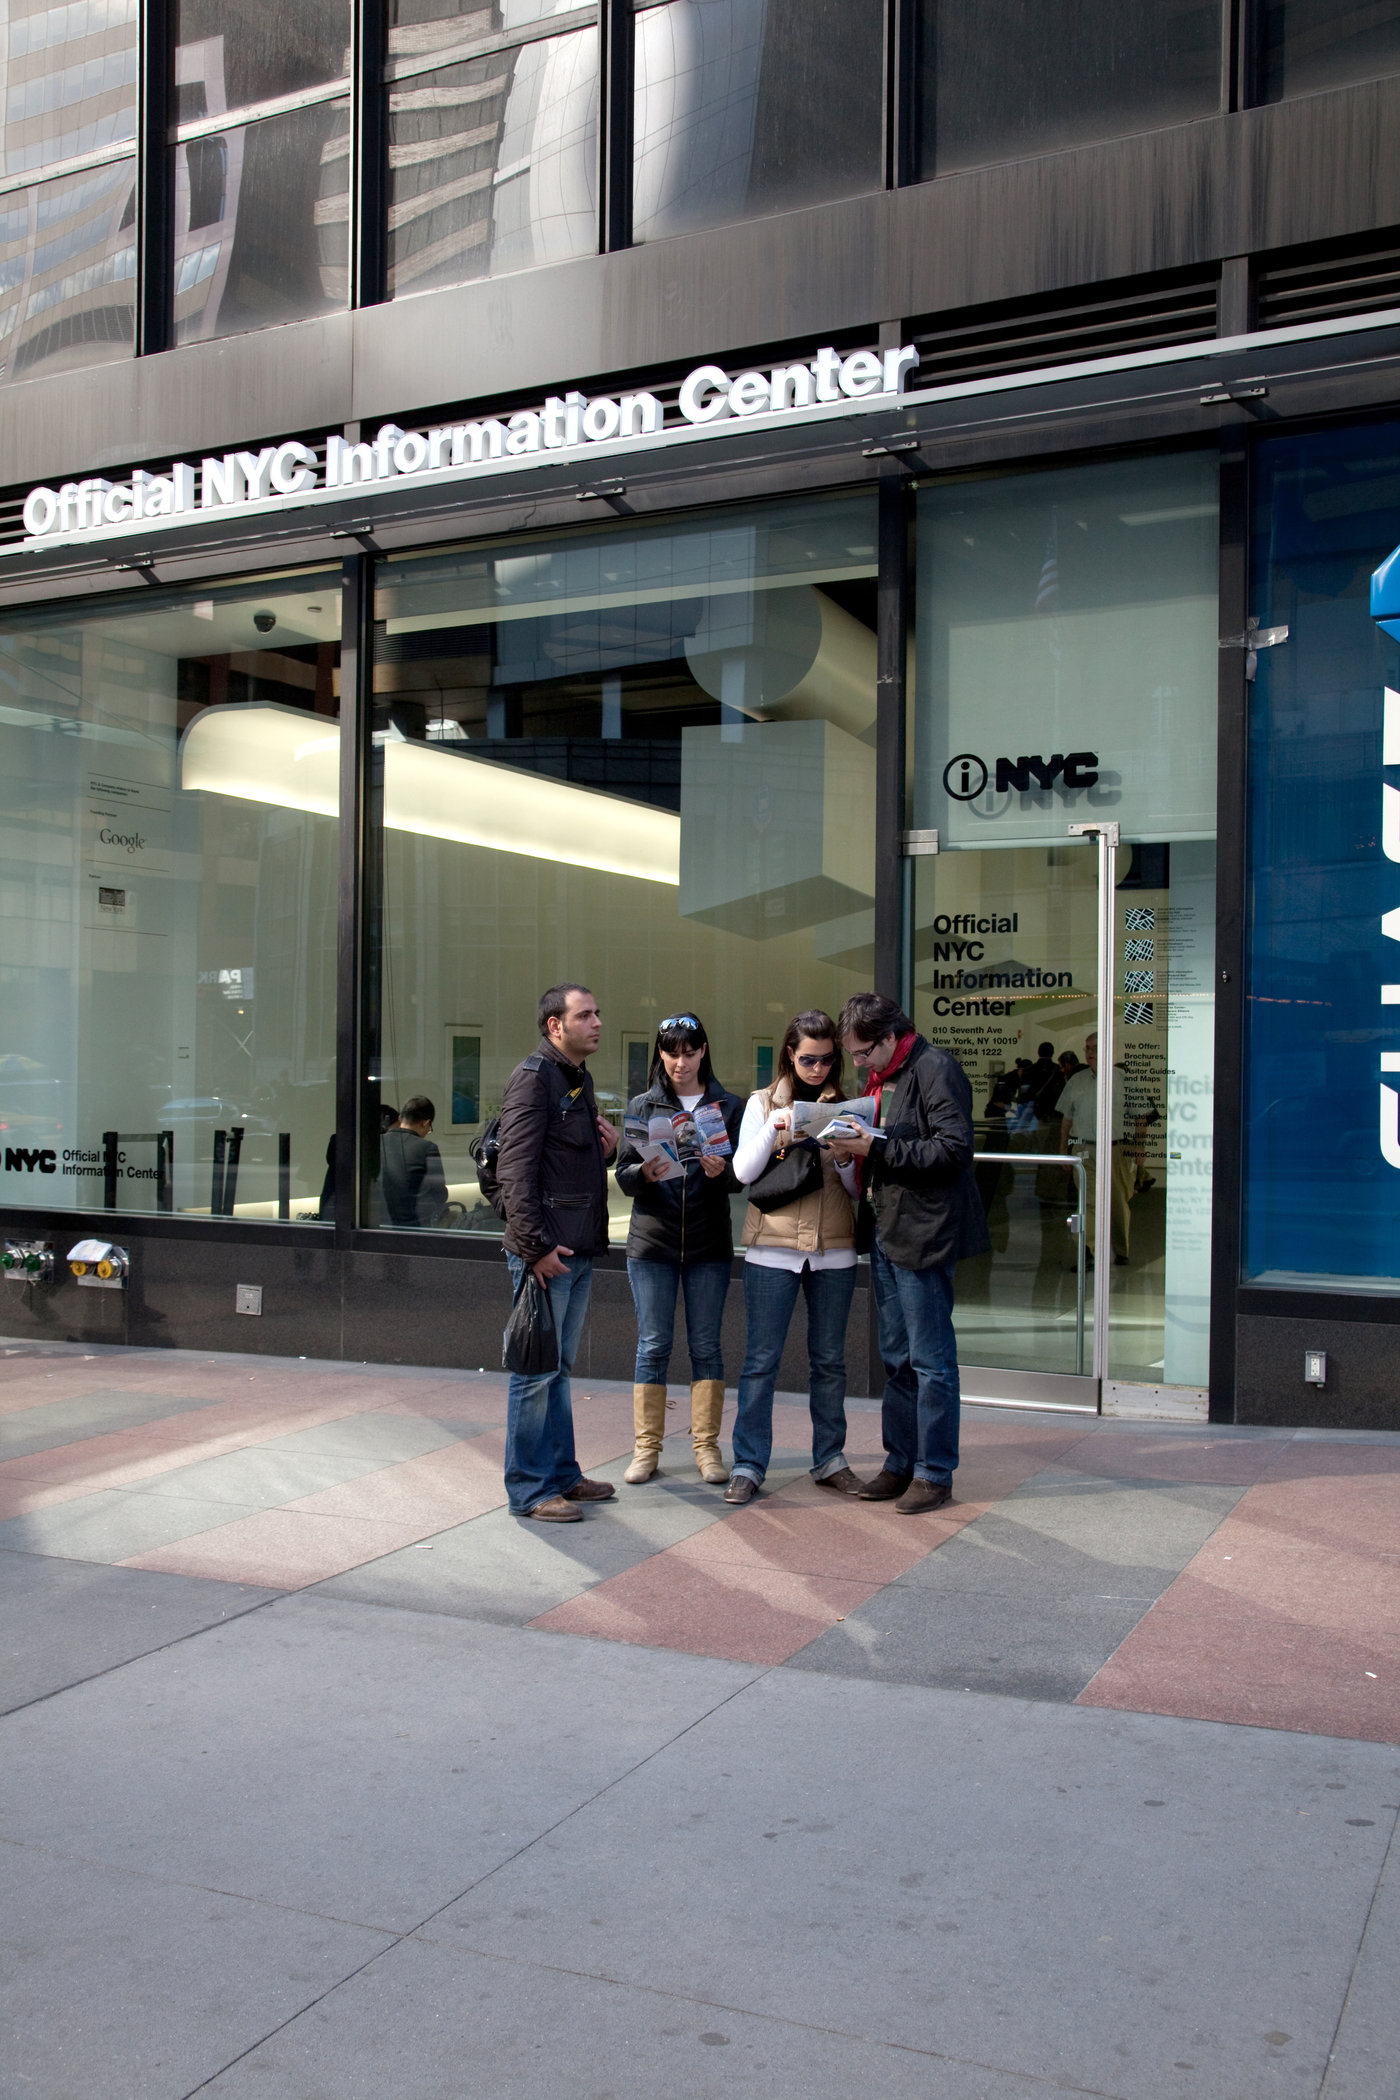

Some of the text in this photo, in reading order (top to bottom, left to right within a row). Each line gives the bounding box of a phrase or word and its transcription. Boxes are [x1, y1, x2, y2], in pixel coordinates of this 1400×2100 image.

[23, 344, 919, 536] Official NYC Information Center
[996, 752, 1099, 793] NYC
[100, 828, 145, 854] Google
[933, 913, 1018, 935] Official
[933, 941, 985, 962] NYC
[933, 968, 1073, 989] Information
[933, 995, 1016, 1016] Center
[932, 1026, 1003, 1034] 810 Seventh Ave
[932, 1037, 1018, 1046] New York, NY 10019
[962, 1048, 978, 1056] 484
[982, 1048, 1002, 1056] 1222
[1067, 1136, 1083, 1147] pull
[5, 1148, 57, 1174] NYC
[62, 1149, 100, 1163] Official
